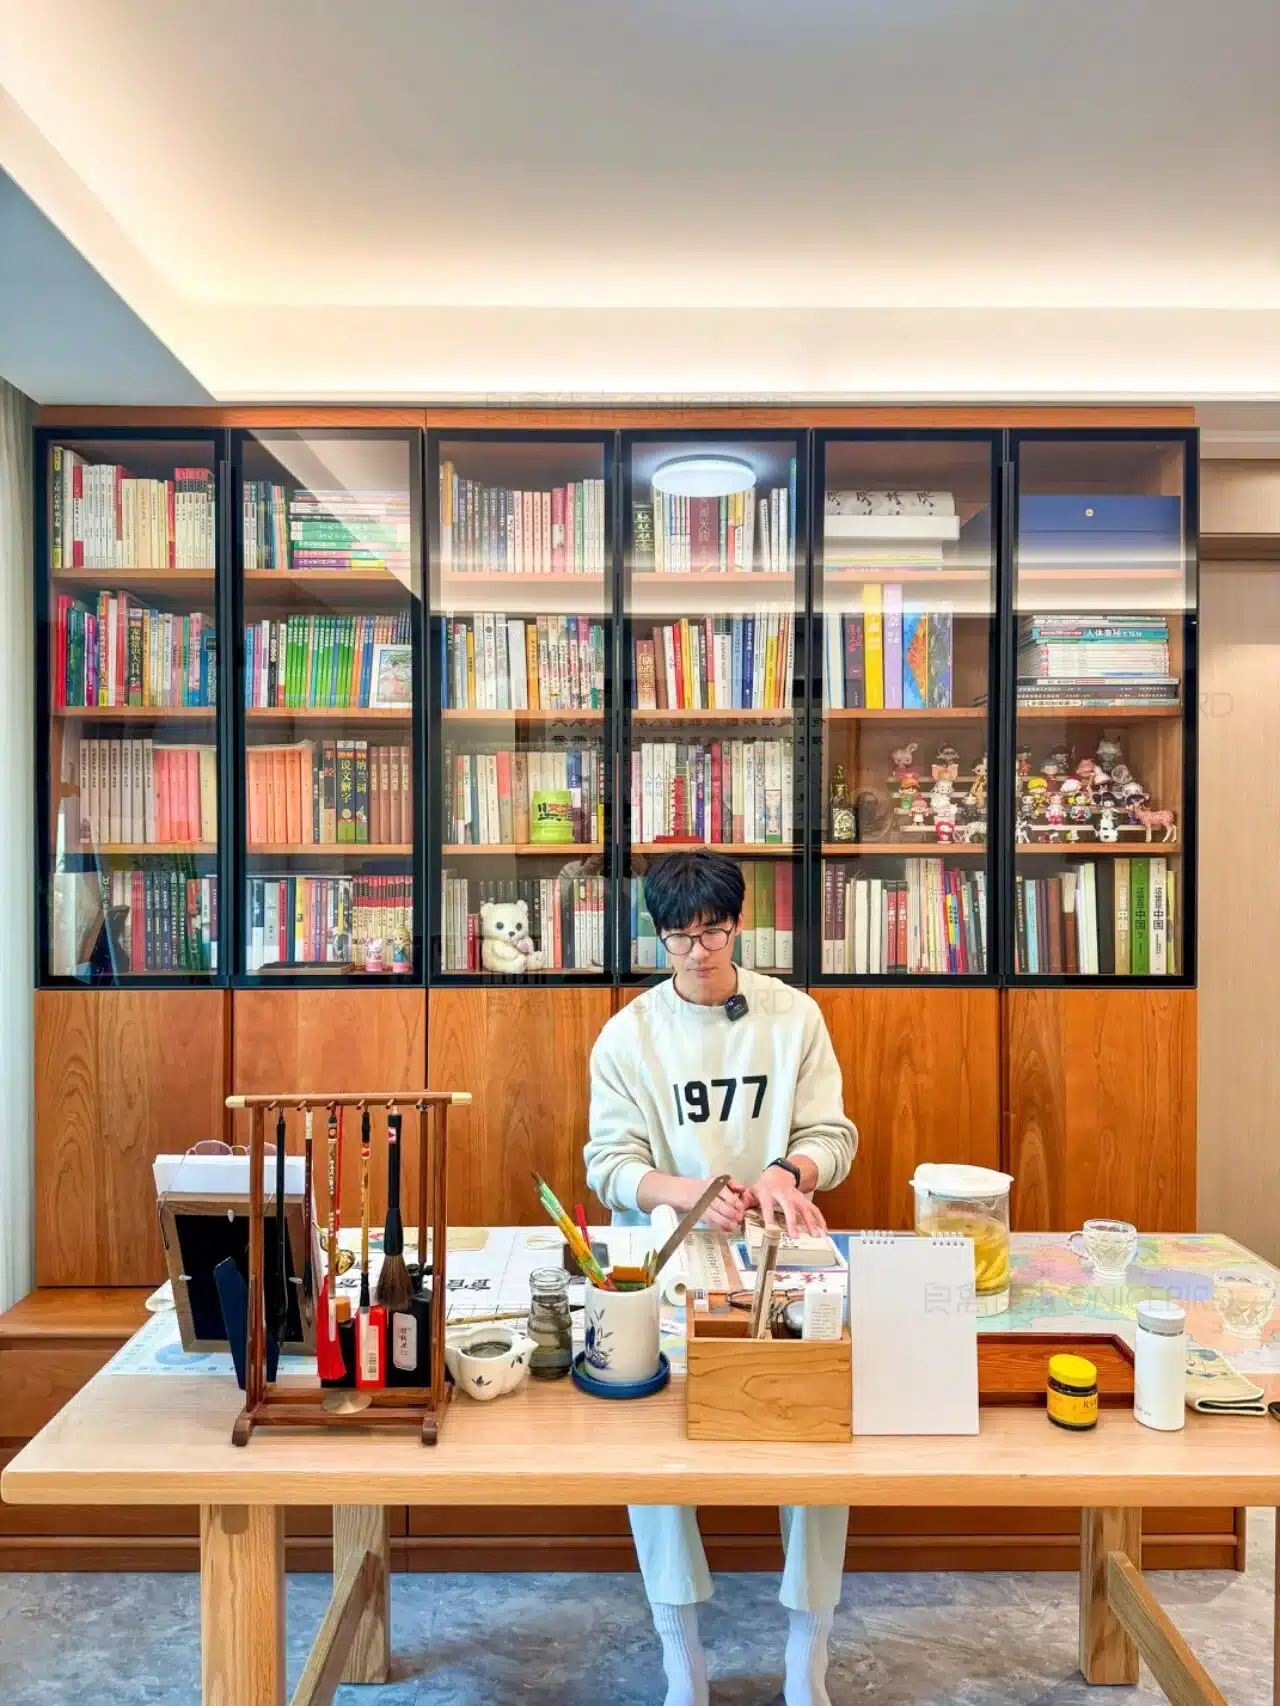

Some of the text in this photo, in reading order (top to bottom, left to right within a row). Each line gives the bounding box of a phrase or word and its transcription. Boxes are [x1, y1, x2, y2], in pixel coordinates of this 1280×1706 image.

[340, 759, 352, 803] 说文解字
[672, 1074, 768, 1126] 1977
